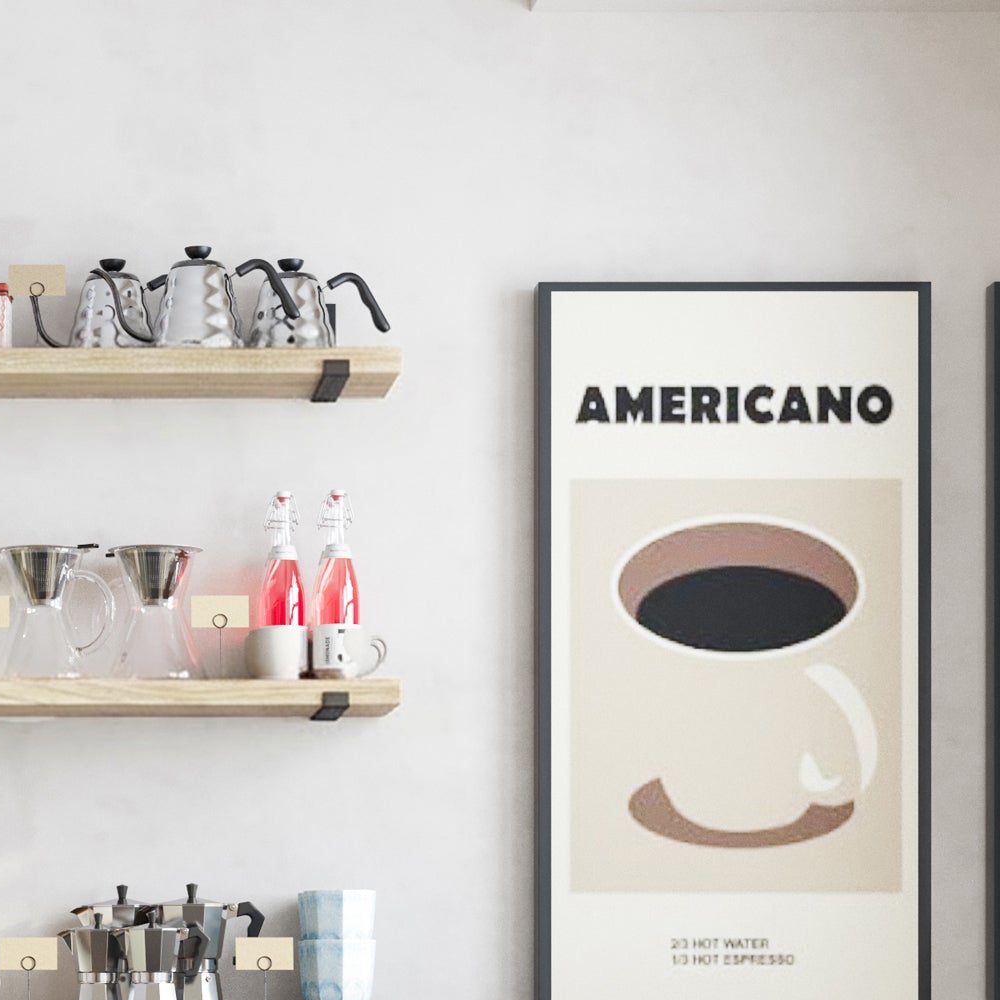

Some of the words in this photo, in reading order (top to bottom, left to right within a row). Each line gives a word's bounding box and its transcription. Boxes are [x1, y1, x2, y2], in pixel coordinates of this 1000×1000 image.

[575, 385, 893, 425] AMERICANO
[693, 938, 719, 949] HOT
[723, 938, 769, 949] WATER
[693, 955, 719, 965] HOT
[723, 955, 795, 965] ESPRESSO
